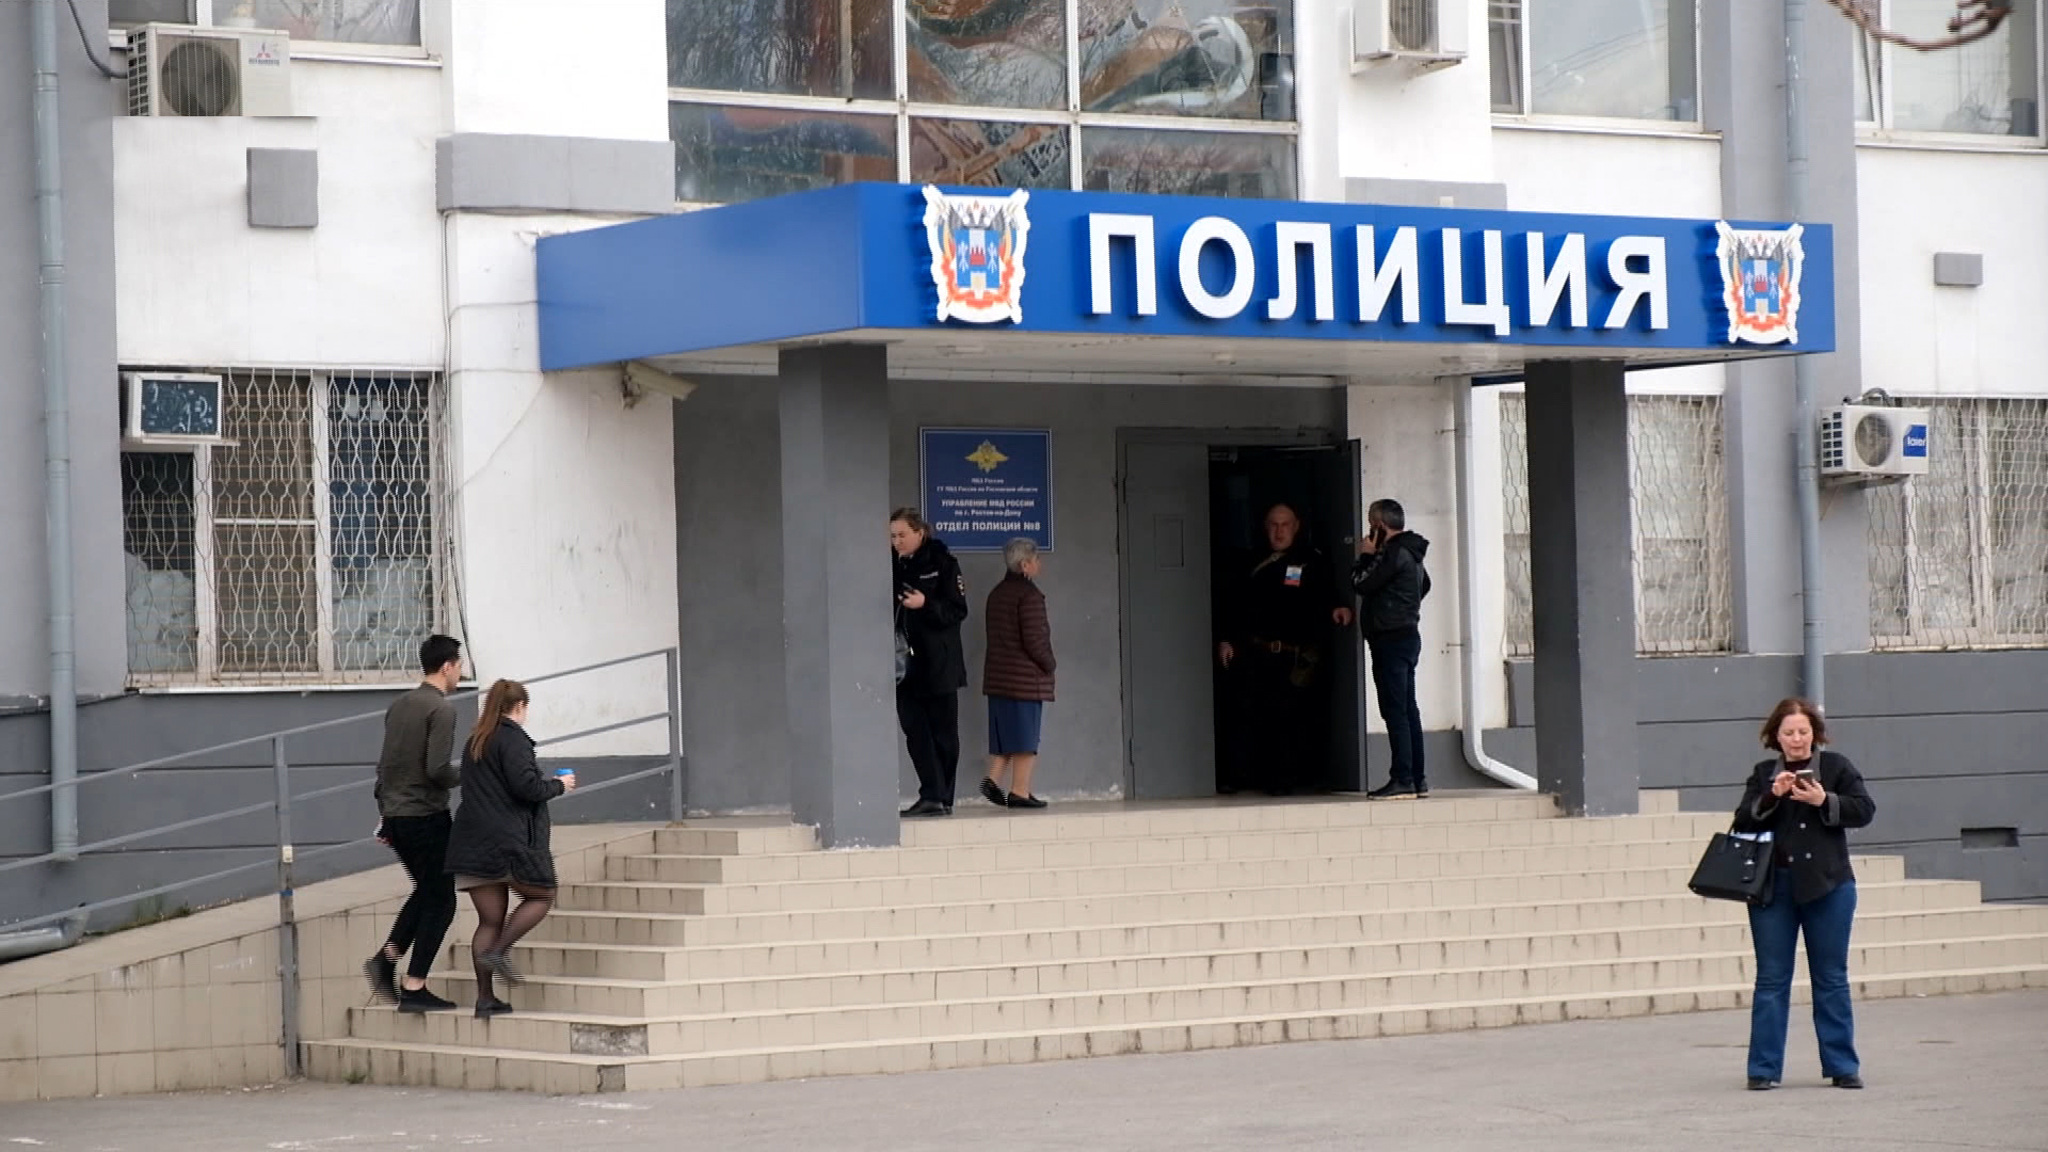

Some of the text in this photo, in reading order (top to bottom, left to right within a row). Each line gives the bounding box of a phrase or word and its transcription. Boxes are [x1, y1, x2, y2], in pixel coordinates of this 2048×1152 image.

[1088, 212, 1669, 336] ПОЛИЦИЯ
[941, 499, 1035, 507] УПРАВЛЕНИЕ МВД РОССИИ
[936, 521, 1041, 532] ОТДЕЛ ПОЛИЦИИ №8
